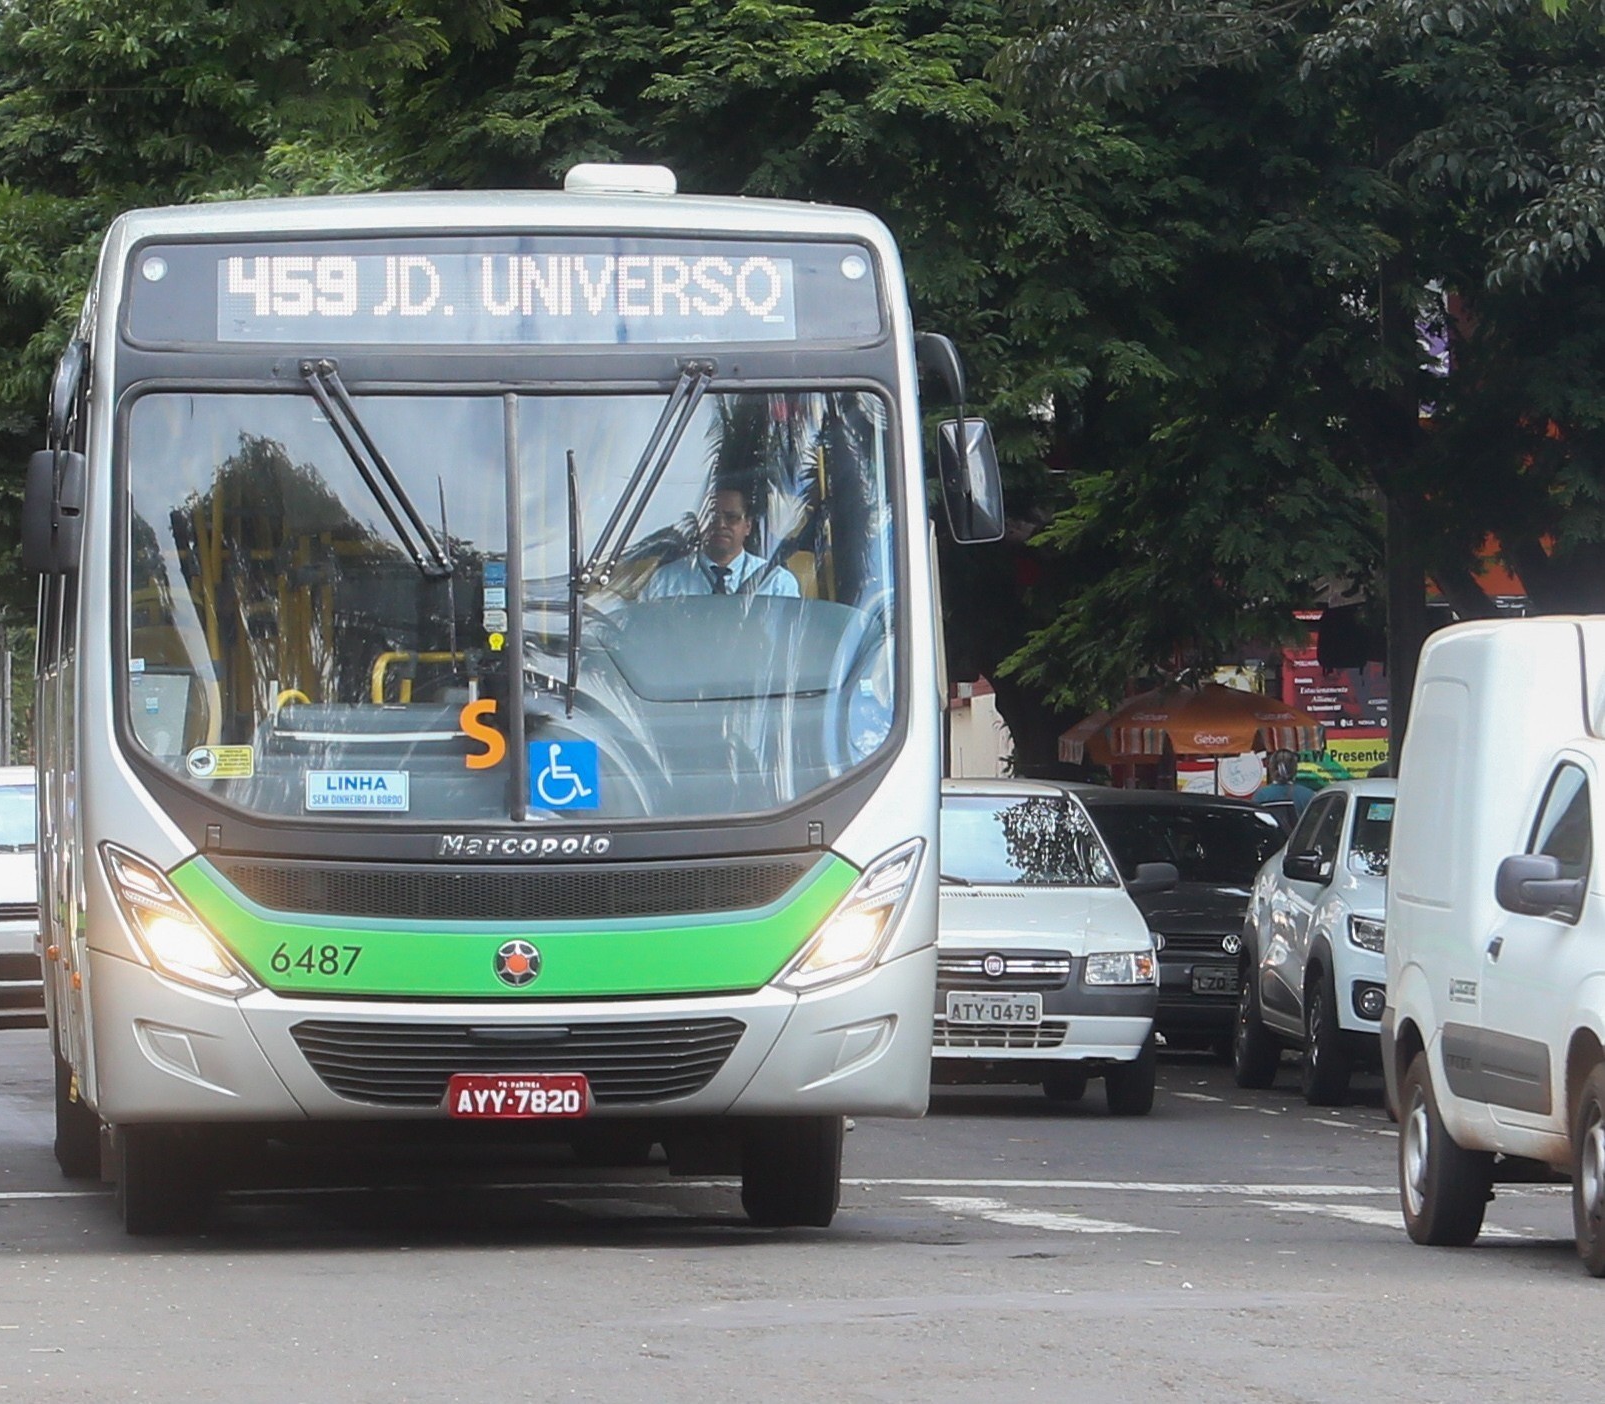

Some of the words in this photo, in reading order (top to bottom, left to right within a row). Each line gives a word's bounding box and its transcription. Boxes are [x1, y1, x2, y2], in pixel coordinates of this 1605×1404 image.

[228, 256, 357, 316] 459
[373, 256, 454, 316] JD.
[482, 256, 782, 316] UNIVERSO
[459, 698, 506, 769] S
[326, 776, 388, 791] LINHA
[312, 794, 329, 805] SEM
[331, 794, 367, 805] DINHEIRO
[368, 794, 375, 805] A
[377, 794, 403, 805] BORDO
[438, 834, 611, 858] Marcopolo
[270, 942, 363, 976] 6487
[457, 1089, 580, 1113] AYY-7820
